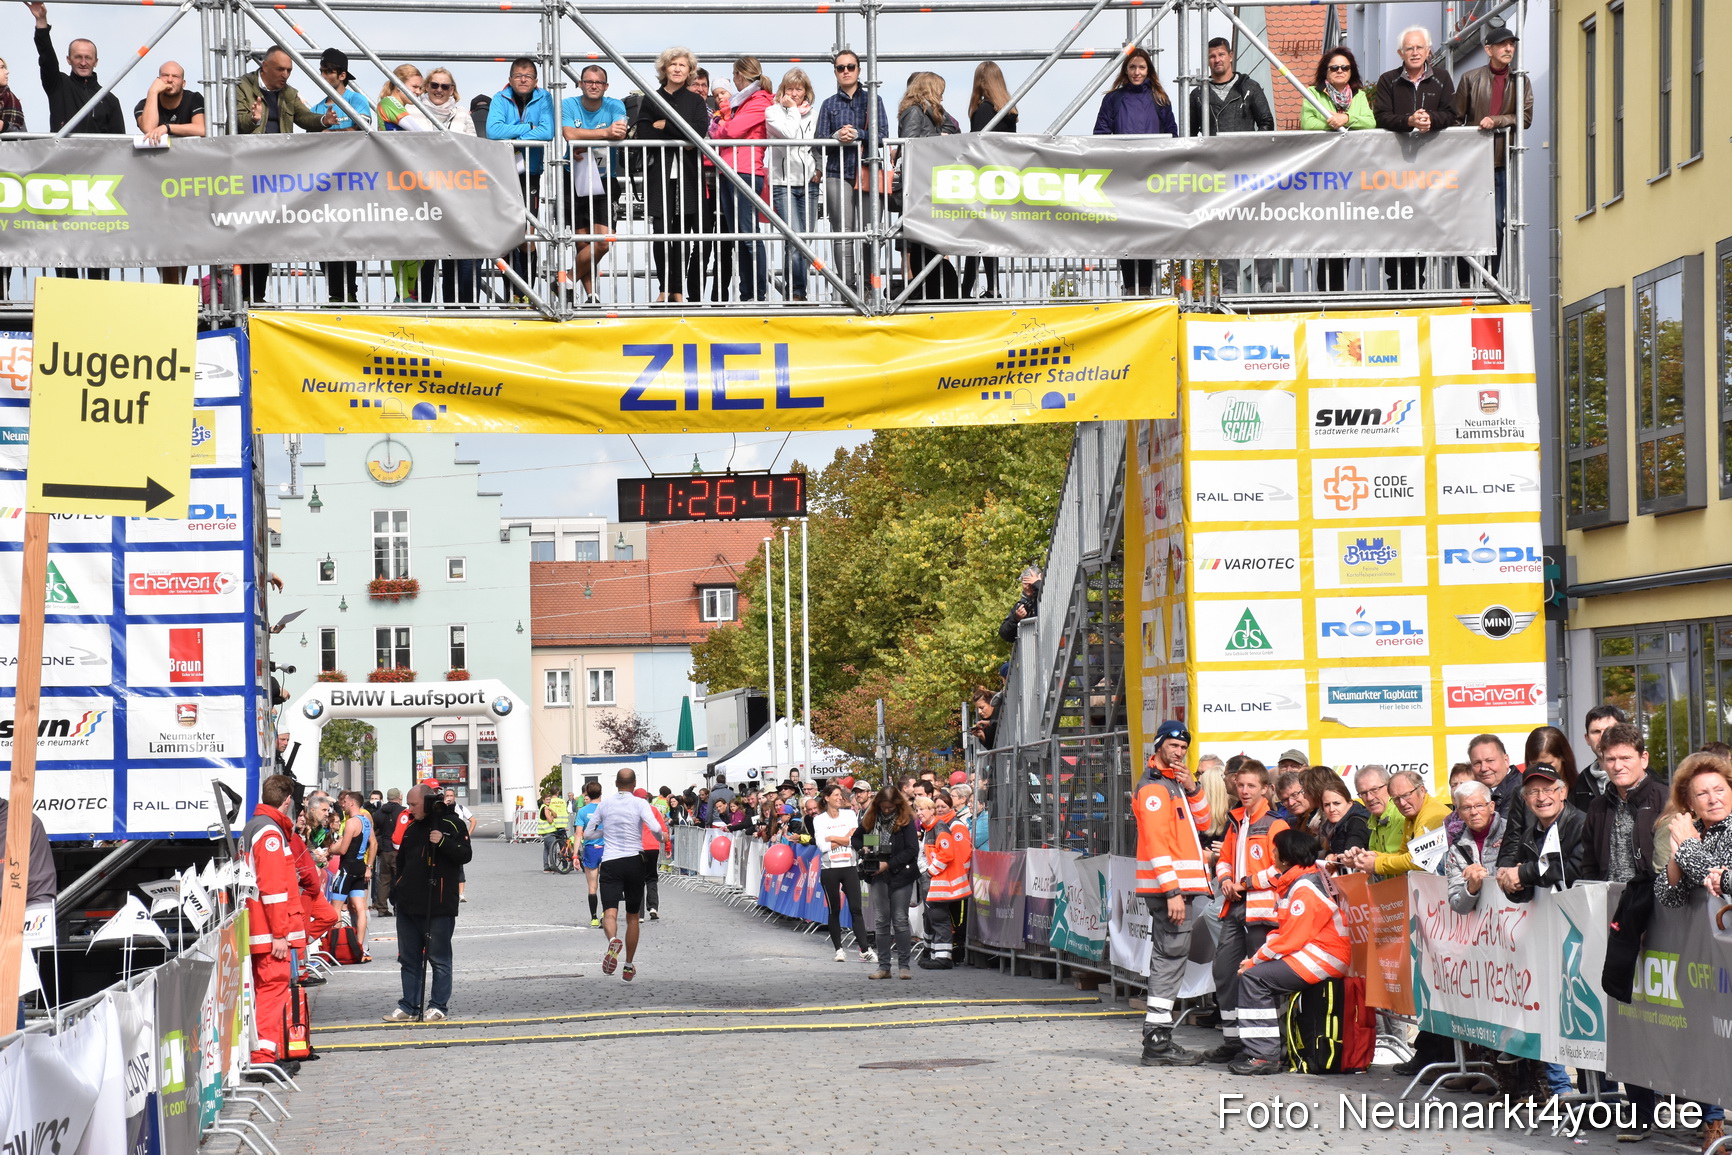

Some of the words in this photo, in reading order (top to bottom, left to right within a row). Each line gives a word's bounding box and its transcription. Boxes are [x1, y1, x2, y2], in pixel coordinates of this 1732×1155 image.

[160, 175, 244, 199] OFFICE
[251, 172, 379, 195] INDUSTRY
[386, 169, 488, 191] LOUNGE
[936, 167, 1104, 204] BOCK
[1146, 173, 1226, 194] OFFICE
[1234, 171, 1353, 191] INDUSTRY
[1360, 169, 1459, 190] LOUNGE
[0, 177, 117, 211] OCK
[211, 202, 443, 227] www.bockonline.de
[931, 206, 986, 222] inspired
[990, 208, 1007, 222] by
[1011, 209, 1052, 221] smart
[1055, 210, 1118, 224] concepts
[1194, 201, 1414, 222] www.bockonline.de
[13, 219, 58, 230] smart
[62, 219, 129, 232] concepts
[1368, 354, 1398, 363] KANN
[1472, 346, 1502, 360] Braun
[39, 341, 191, 387] Jugend-
[619, 342, 825, 411] ZIEL
[937, 370, 1044, 391] Neumarkter
[1048, 364, 1130, 385] Stadtlauf
[301, 377, 413, 395] Neumarkter
[417, 379, 503, 397] Stadtlauf
[80, 388, 150, 425] lauf
[1223, 397, 1257, 420] RUND
[1315, 408, 1382, 426] swn
[1464, 417, 1516, 427] Neumarkter
[1222, 419, 1264, 443] SCHAU
[1314, 427, 1359, 436] stadtwerke
[1361, 426, 1400, 435] neumarkt
[1455, 427, 1525, 440] Lammsbräu
[1373, 475, 1408, 487] CODE
[1373, 486, 1415, 498] CLINIC
[1343, 545, 1398, 565] Burgis
[1224, 557, 1295, 571] VARIOTEC
[133, 573, 210, 590] charivari
[1484, 617, 1511, 628] MINI
[170, 658, 201, 672] Braun
[330, 690, 385, 707] BMW
[390, 689, 485, 708] Laufsport
[1332, 690, 1382, 701] Neumarkter
[1382, 689, 1418, 701] Tagblatt
[1451, 685, 1525, 702] charivari
[47, 738, 90, 747] neumarkt
[159, 732, 216, 741] Neumarkter
[149, 741, 225, 754] Lammsbräu
[1414, 840, 1436, 854] swn
[150, 885, 175, 895] swn
[1658, 1013, 1688, 1031] concepts
